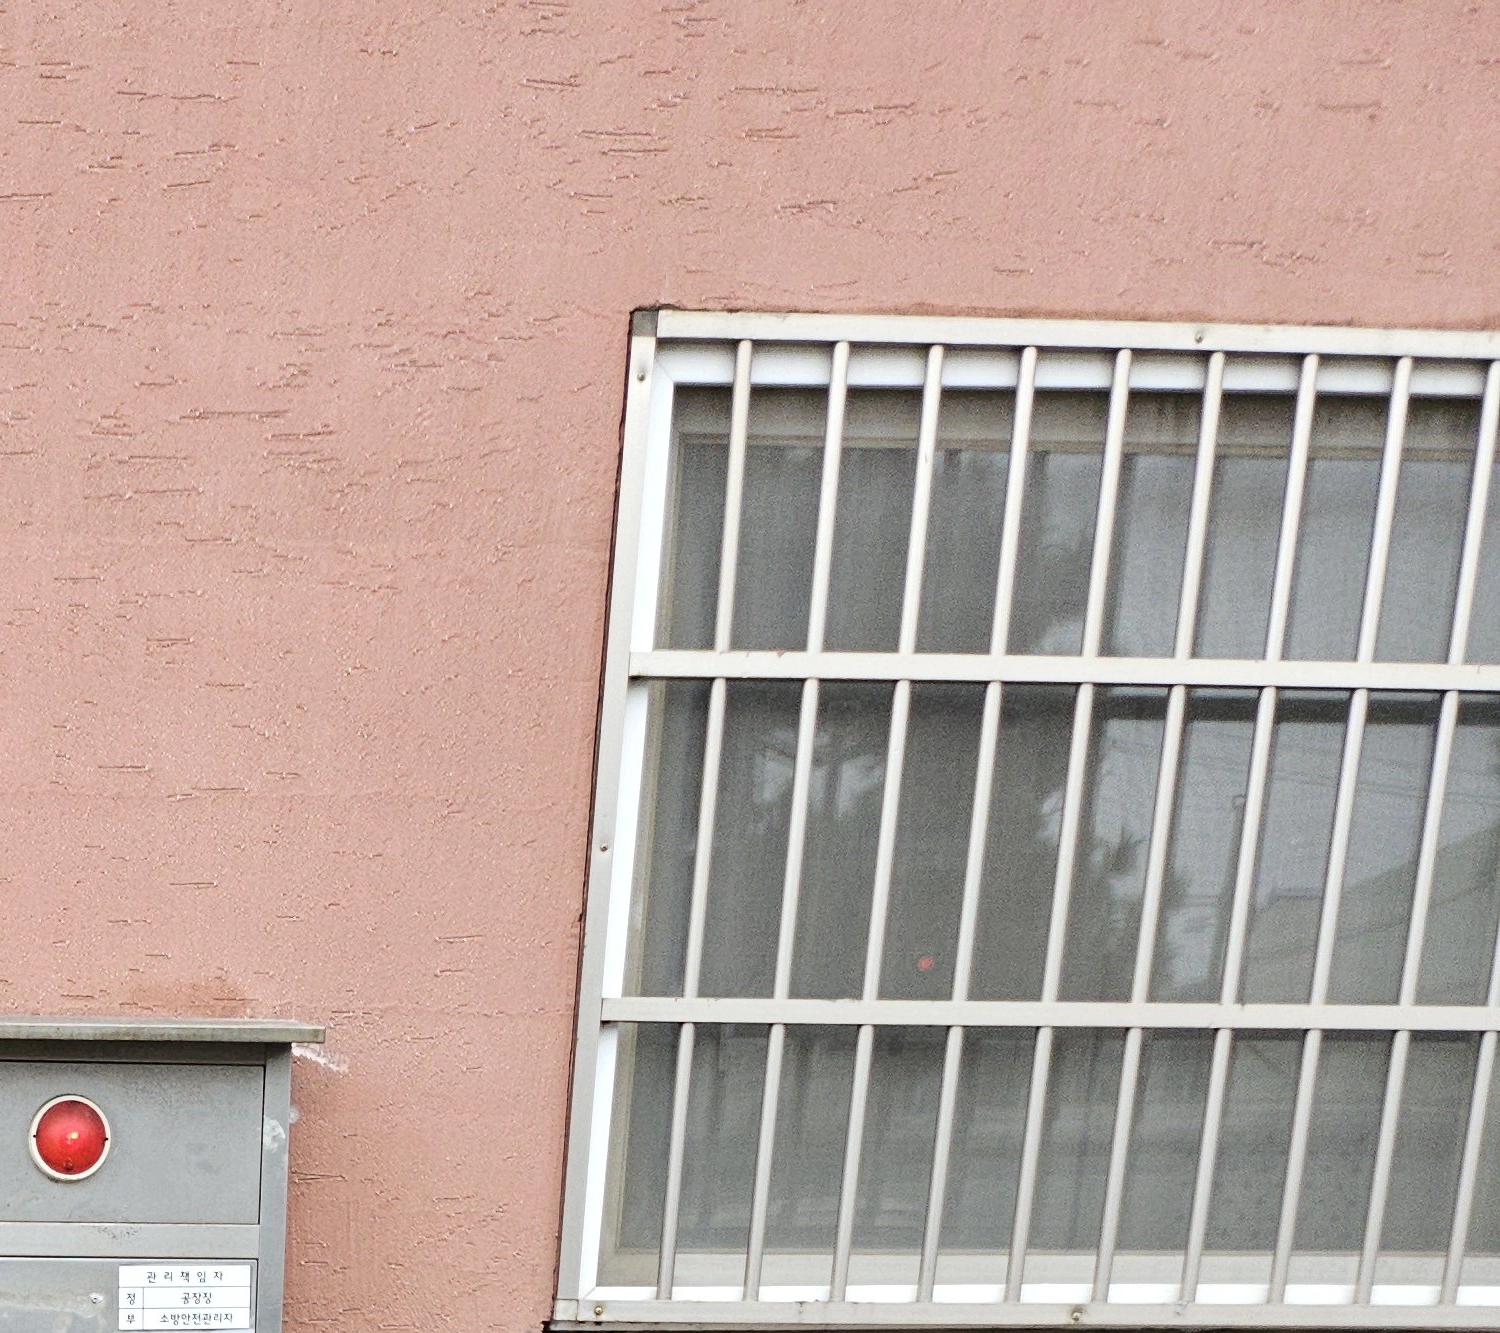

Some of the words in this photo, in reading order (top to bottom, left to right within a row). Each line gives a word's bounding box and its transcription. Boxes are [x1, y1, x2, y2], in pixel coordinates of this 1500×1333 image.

[126, 1292, 136, 1306] 정
[180, 1291, 212, 1305] 공장장
[126, 1313, 136, 1325] 부
[159, 1312, 234, 1326] 소방안전관리자
